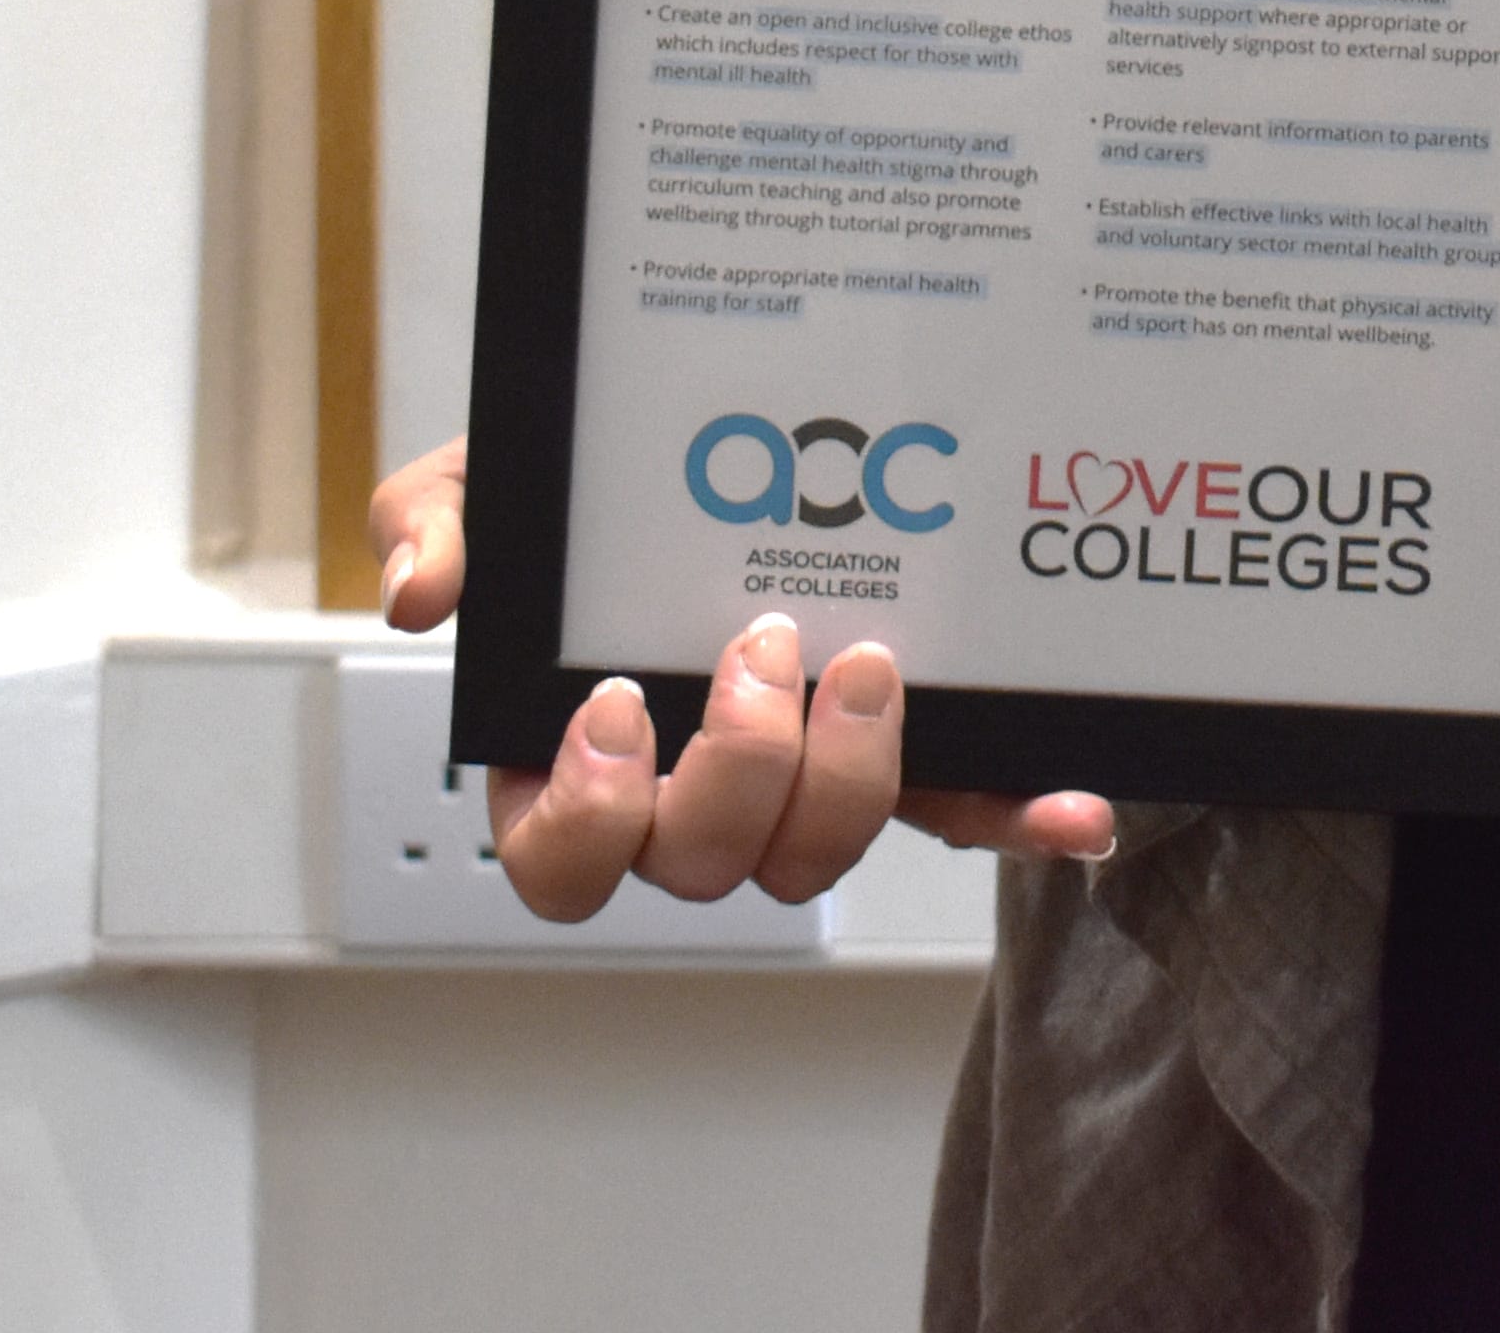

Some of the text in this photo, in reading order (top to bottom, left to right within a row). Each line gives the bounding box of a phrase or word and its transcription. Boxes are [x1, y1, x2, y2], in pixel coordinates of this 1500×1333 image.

[1102, 112, 1490, 151] Provide relevant information to parents
[1100, 141, 1205, 164] and carers
[643, 260, 980, 294] Provide appropriate mental health
[640, 289, 802, 314] training for staff
[1094, 283, 1494, 325] Promote the benefit that physical activity
[1092, 312, 1435, 351] and sport has on mental wellbeing.
[746, 549, 900, 573] ASSOCIATION
[1020, 520, 1431, 596] COLLEGES
[744, 574, 899, 600] OF COLLEGES
